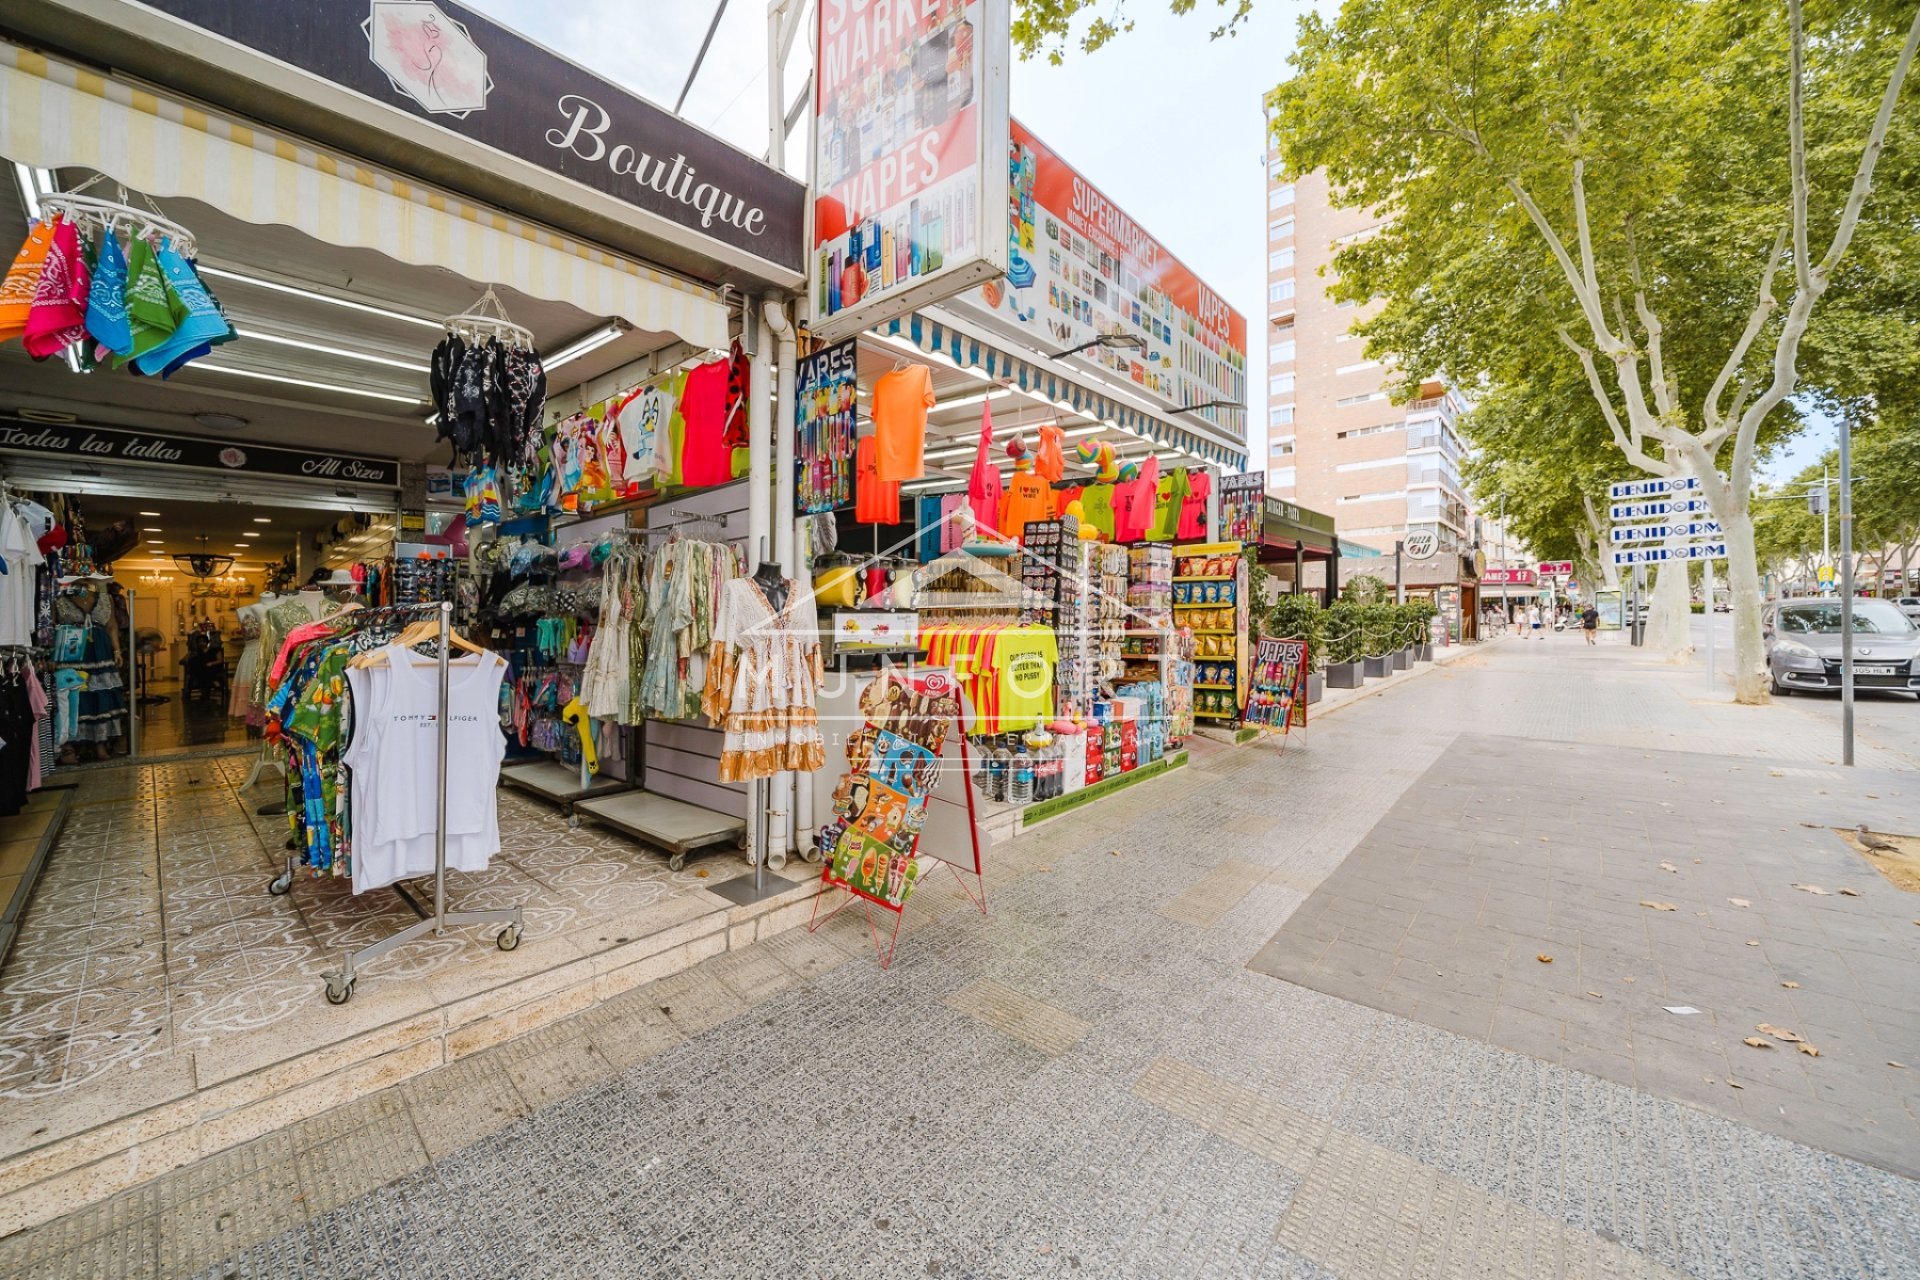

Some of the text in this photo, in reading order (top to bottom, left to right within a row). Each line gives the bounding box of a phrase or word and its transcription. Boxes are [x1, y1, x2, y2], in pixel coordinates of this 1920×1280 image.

[826, 0, 951, 93] MARK
[545, 95, 766, 235] Boutique
[842, 130, 941, 229] VAPES
[1072, 176, 1158, 271] SUPERMARKET
[1198, 282, 1231, 338] VAPES
[0, 427, 182, 461] Todas las tallas
[302, 457, 384, 481] All Sizes
[1613, 478, 1700, 497] BENIDOR
[1407, 535, 1432, 545] PIZZA
[1615, 544, 1725, 564] BENIDORM
[1516, 571, 1528, 581] 17
[1258, 640, 1303, 664] VAPES
[393, 714, 426, 722] TOMMY
